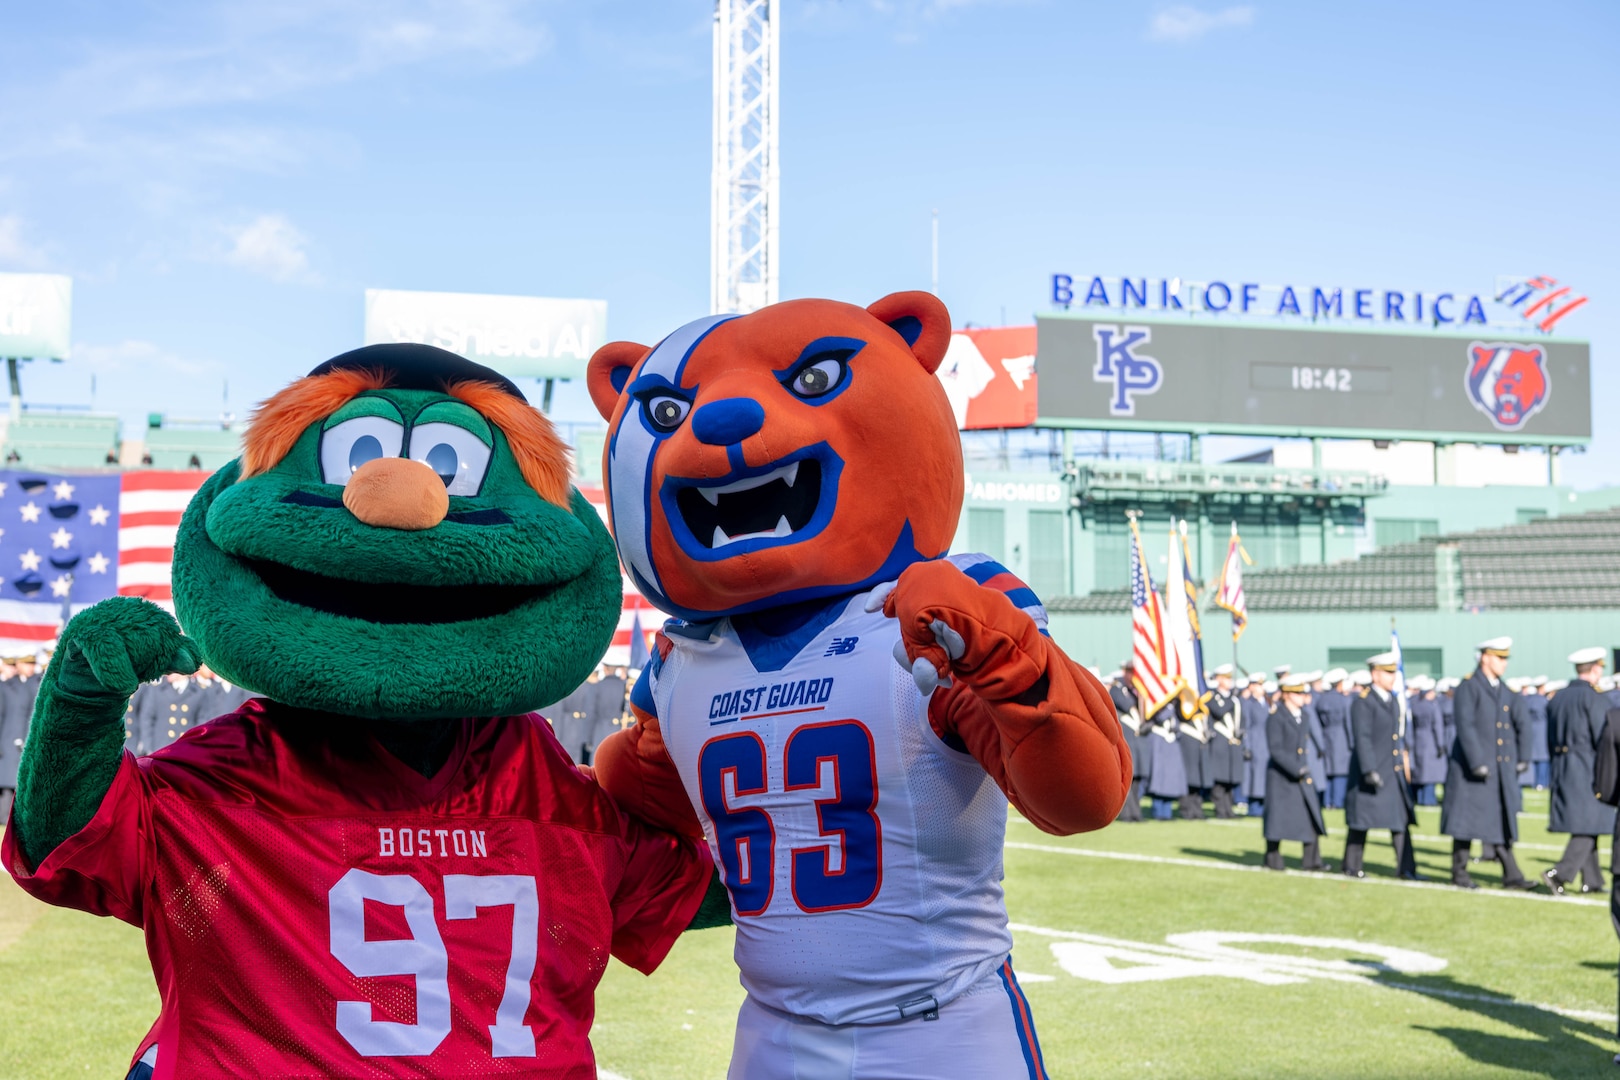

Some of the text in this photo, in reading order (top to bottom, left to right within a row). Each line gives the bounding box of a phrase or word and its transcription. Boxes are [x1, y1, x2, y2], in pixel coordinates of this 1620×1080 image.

[1052, 274, 1488, 325] BANK OF AMERICA
[553, 323, 590, 360] AI
[1291, 366, 1353, 393] 18:42
[972, 481, 1061, 503] ABIOMED
[708, 677, 834, 720] COAST GUARD
[698, 718, 883, 917] 63
[378, 827, 488, 858] BOSTON
[328, 867, 541, 1059] 97
